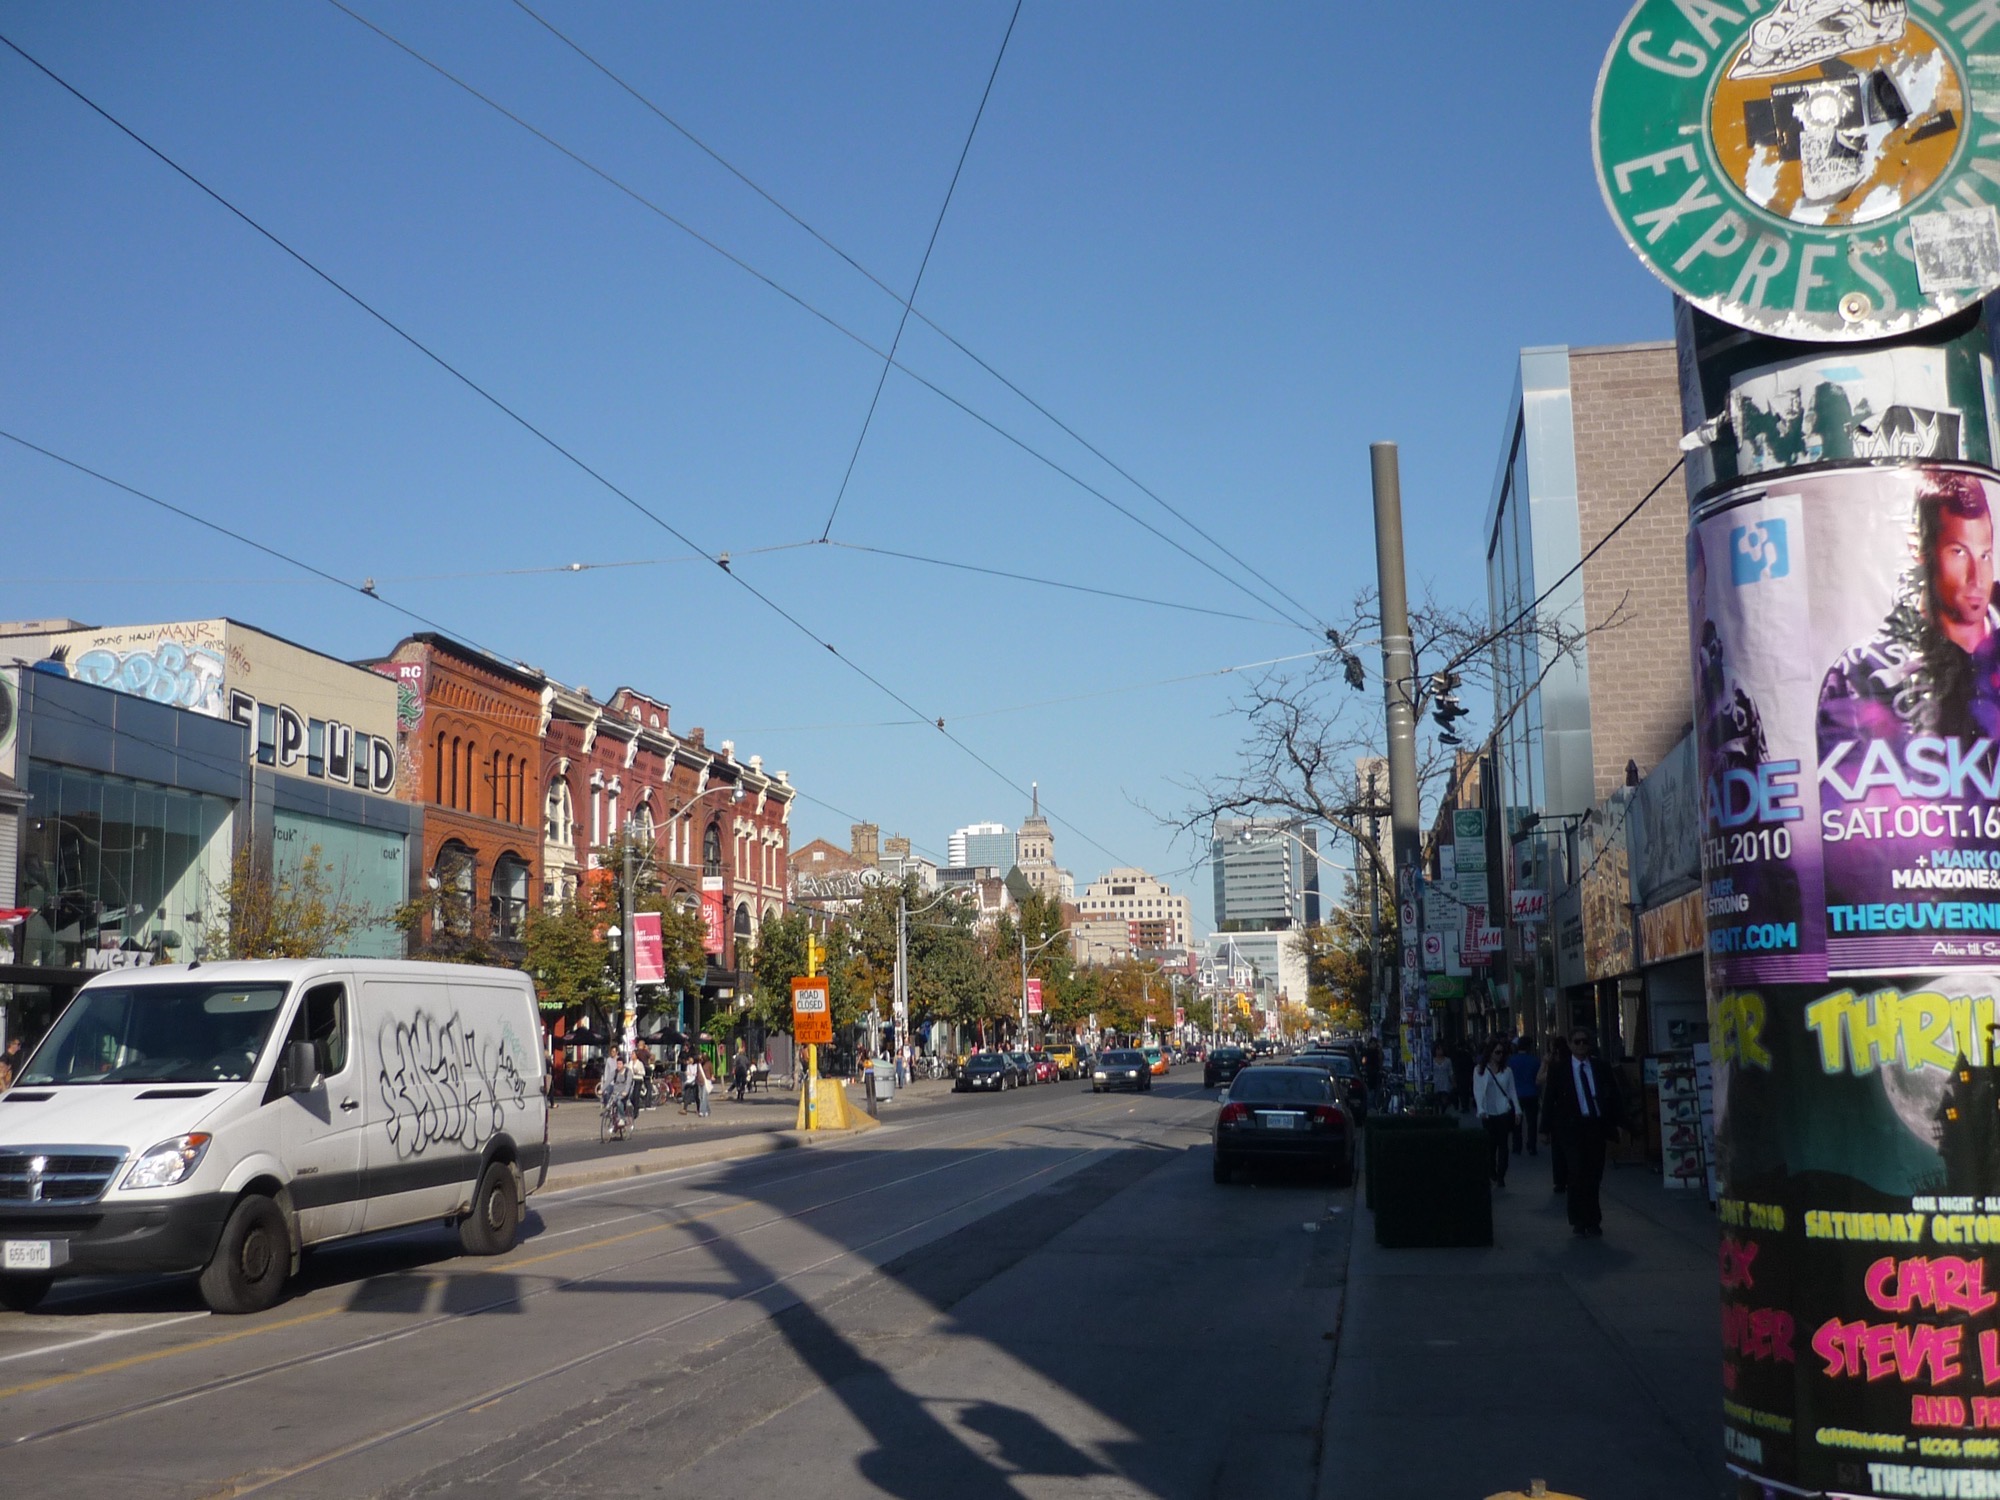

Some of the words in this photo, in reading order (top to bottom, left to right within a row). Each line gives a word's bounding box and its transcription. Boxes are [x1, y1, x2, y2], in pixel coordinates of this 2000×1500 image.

[1817, 736, 2000, 801] KASK
[1931, 850, 1987, 869] MARK
[1931, 941, 1966, 956] Alive
[796, 1000, 823, 1009] CLOSED
[799, 990, 819, 999] ROAD
[1912, 1196, 1937, 1212] ONE
[1938, 1196, 1973, 1212] NIGHT
[1804, 1210, 1925, 1243] SATURDAY
[1864, 1255, 1998, 1317] CARL
[1811, 1317, 1963, 1386] STEVE
[1911, 1395, 1966, 1426] AND
[1919, 1436, 1962, 1458] KOOL
